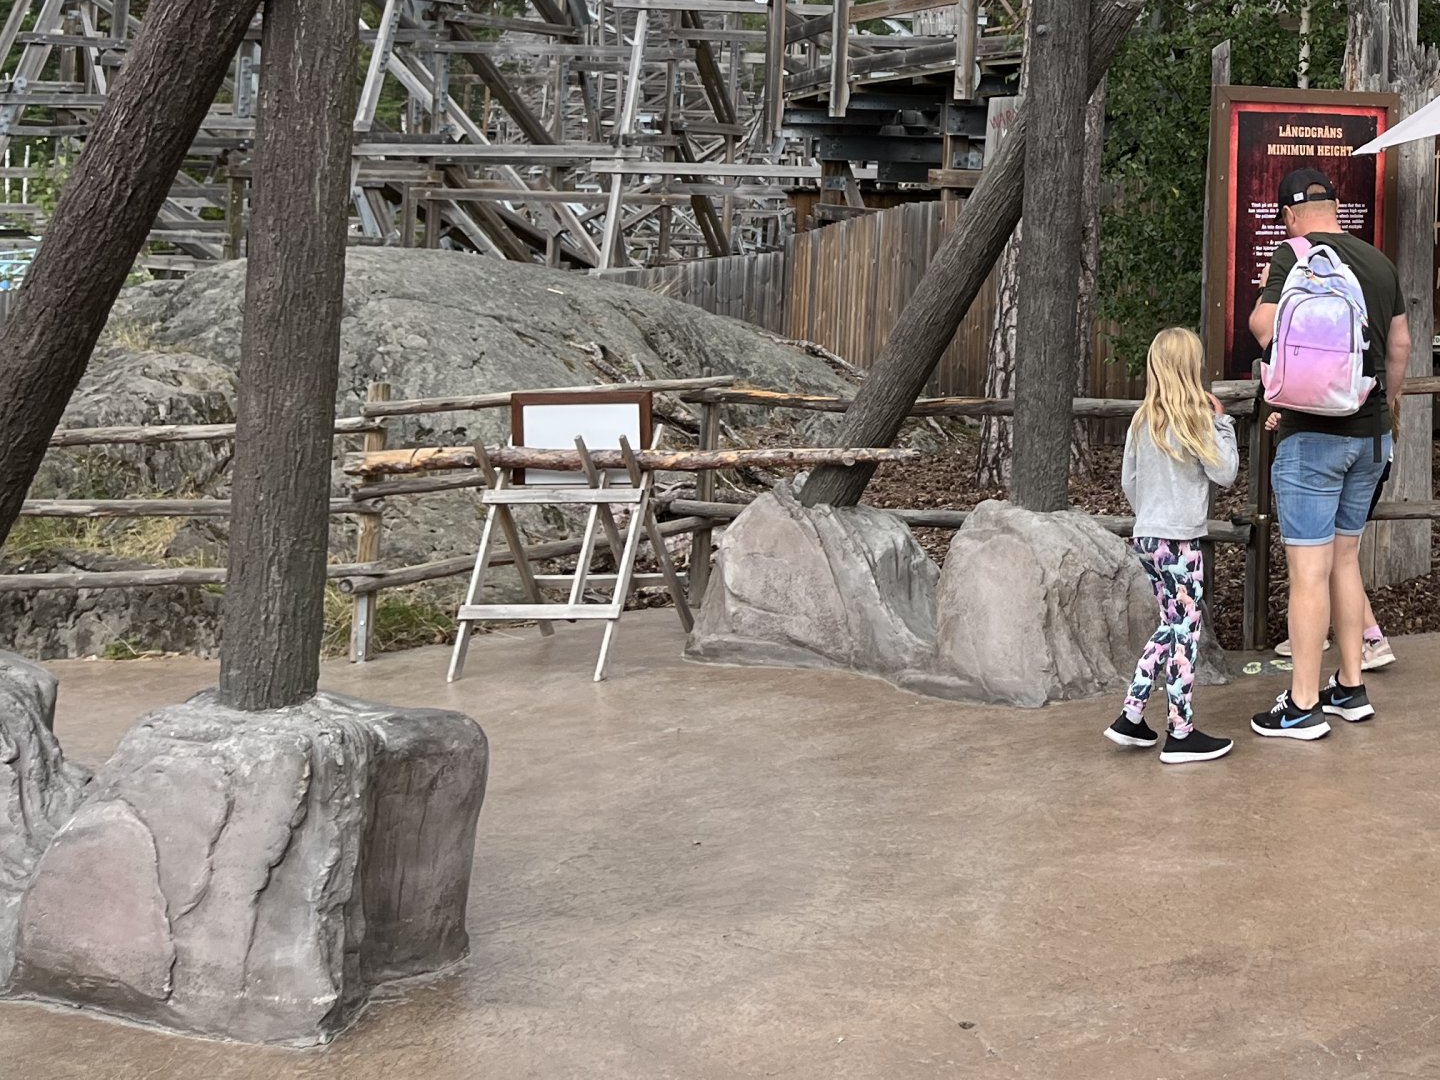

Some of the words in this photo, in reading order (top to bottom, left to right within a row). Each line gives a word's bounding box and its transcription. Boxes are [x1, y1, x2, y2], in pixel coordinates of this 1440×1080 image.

[1278, 124, 1343, 139] LÄNGDGRÄNS
[1267, 143, 1315, 156] MINIMUM
[1317, 145, 1354, 157] HEIGHT
